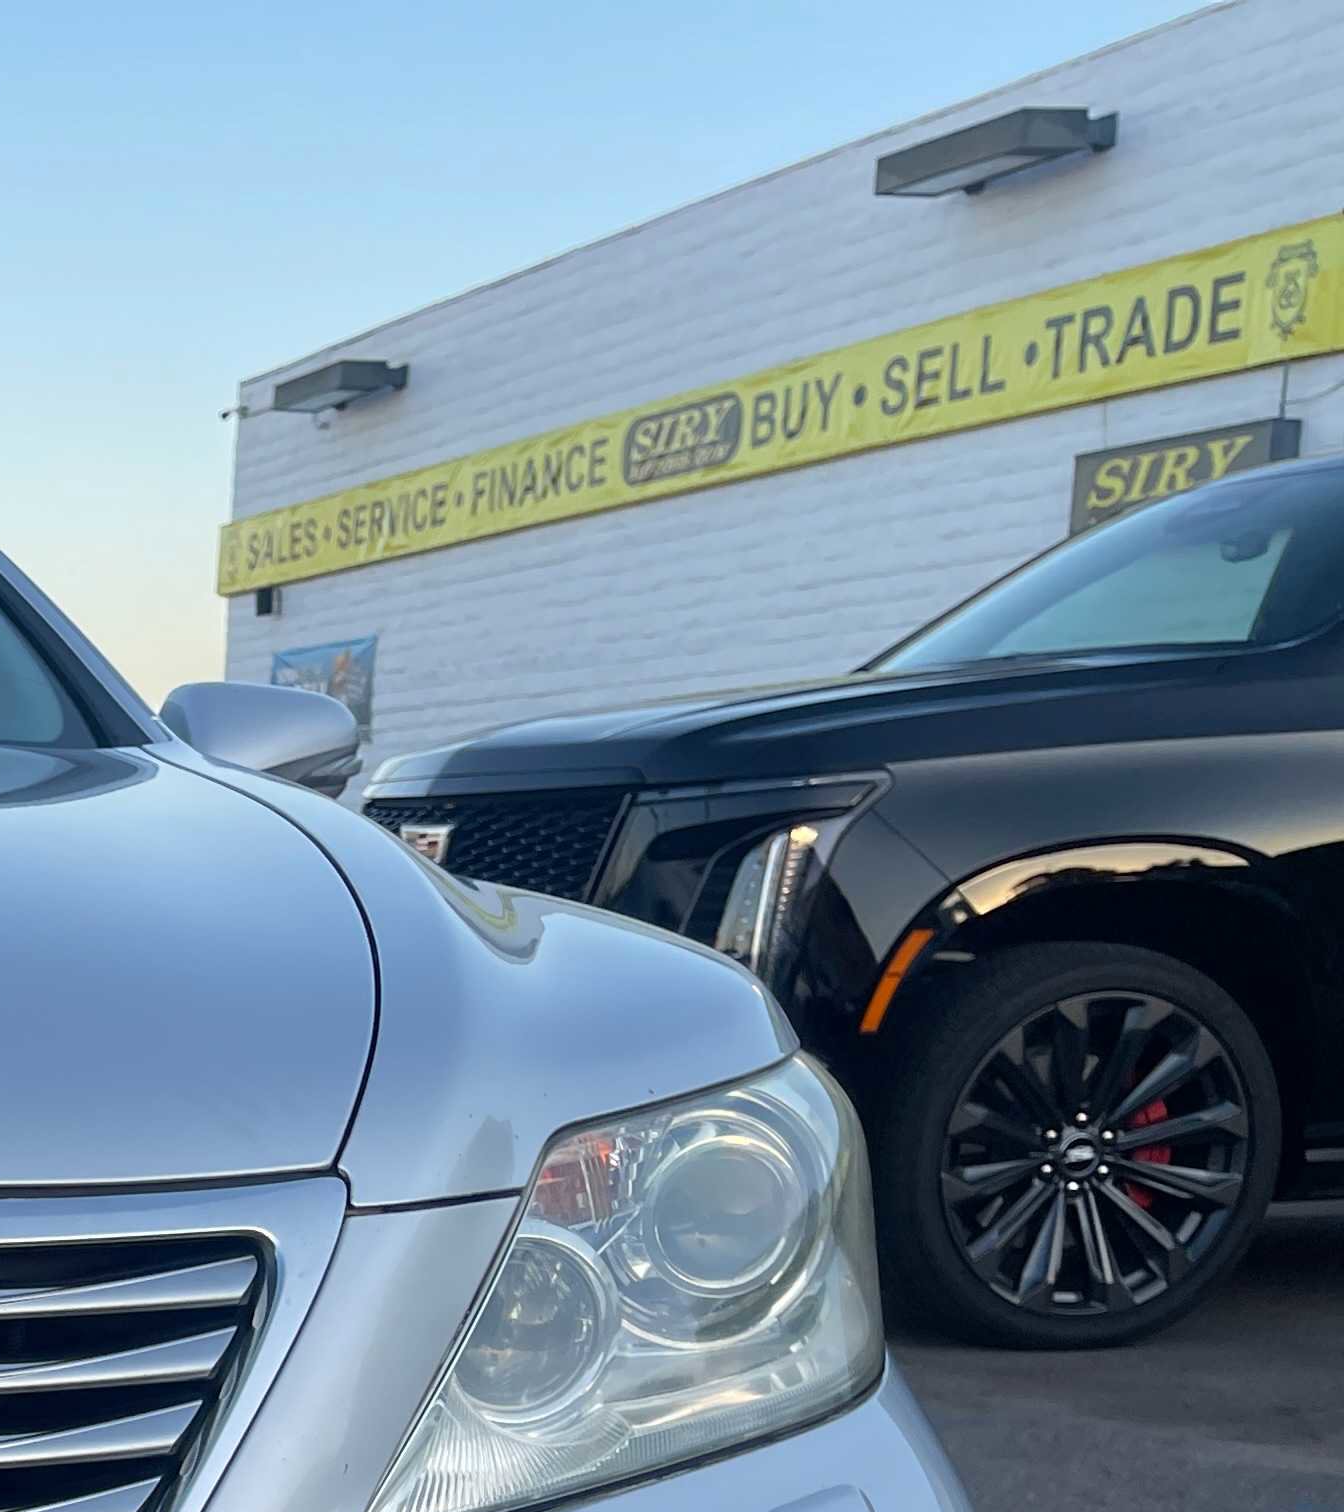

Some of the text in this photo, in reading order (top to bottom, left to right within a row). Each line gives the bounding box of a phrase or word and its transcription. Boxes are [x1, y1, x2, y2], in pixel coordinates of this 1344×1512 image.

[246, 518, 318, 571] SALES
[335, 482, 449, 551] SERVICE
[469, 437, 609, 517] FINANCE
[629, 398, 737, 463] SIRY
[749, 373, 843, 450] BUY
[880, 335, 1008, 416] SELL
[1043, 271, 1248, 380] TRADE
[1086, 434, 1254, 510] SIRY
